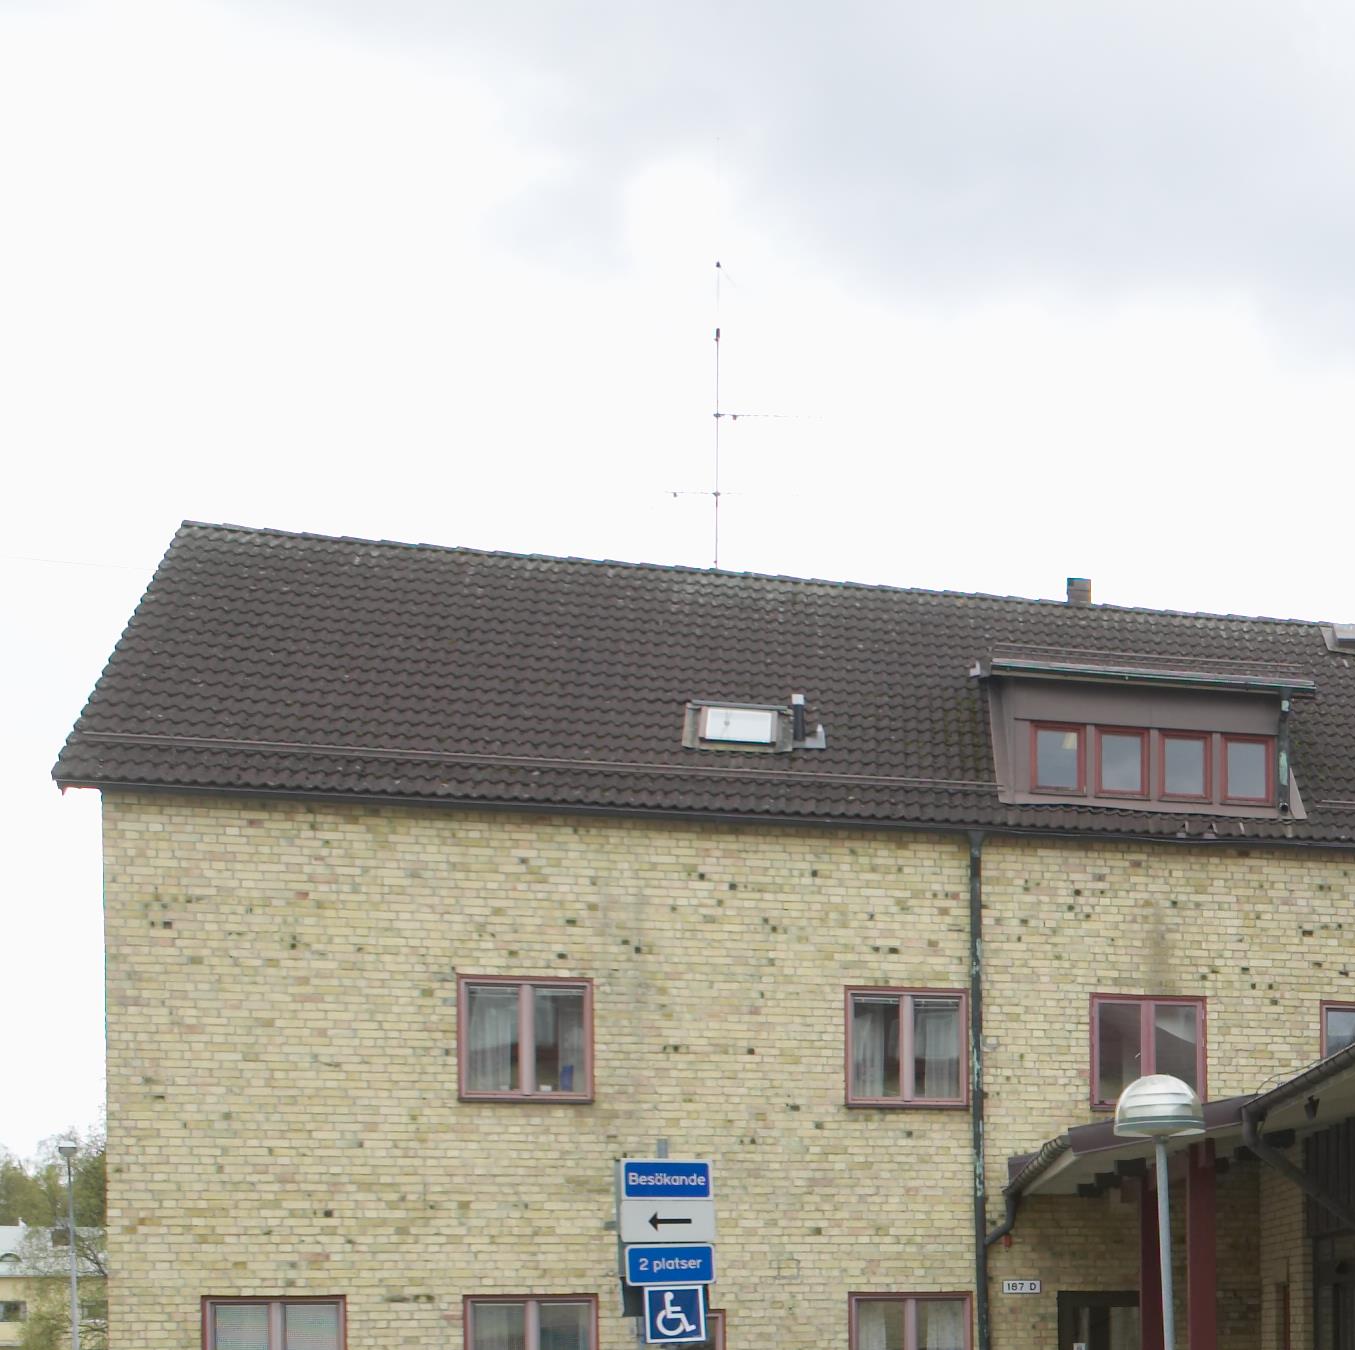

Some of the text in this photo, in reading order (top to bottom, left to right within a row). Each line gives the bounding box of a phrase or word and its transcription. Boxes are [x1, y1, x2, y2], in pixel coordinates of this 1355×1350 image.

[628, 1172, 707, 1186] Besökande
[639, 1257, 703, 1273] 2 platser
[1007, 1282, 1037, 1291] 187 D
